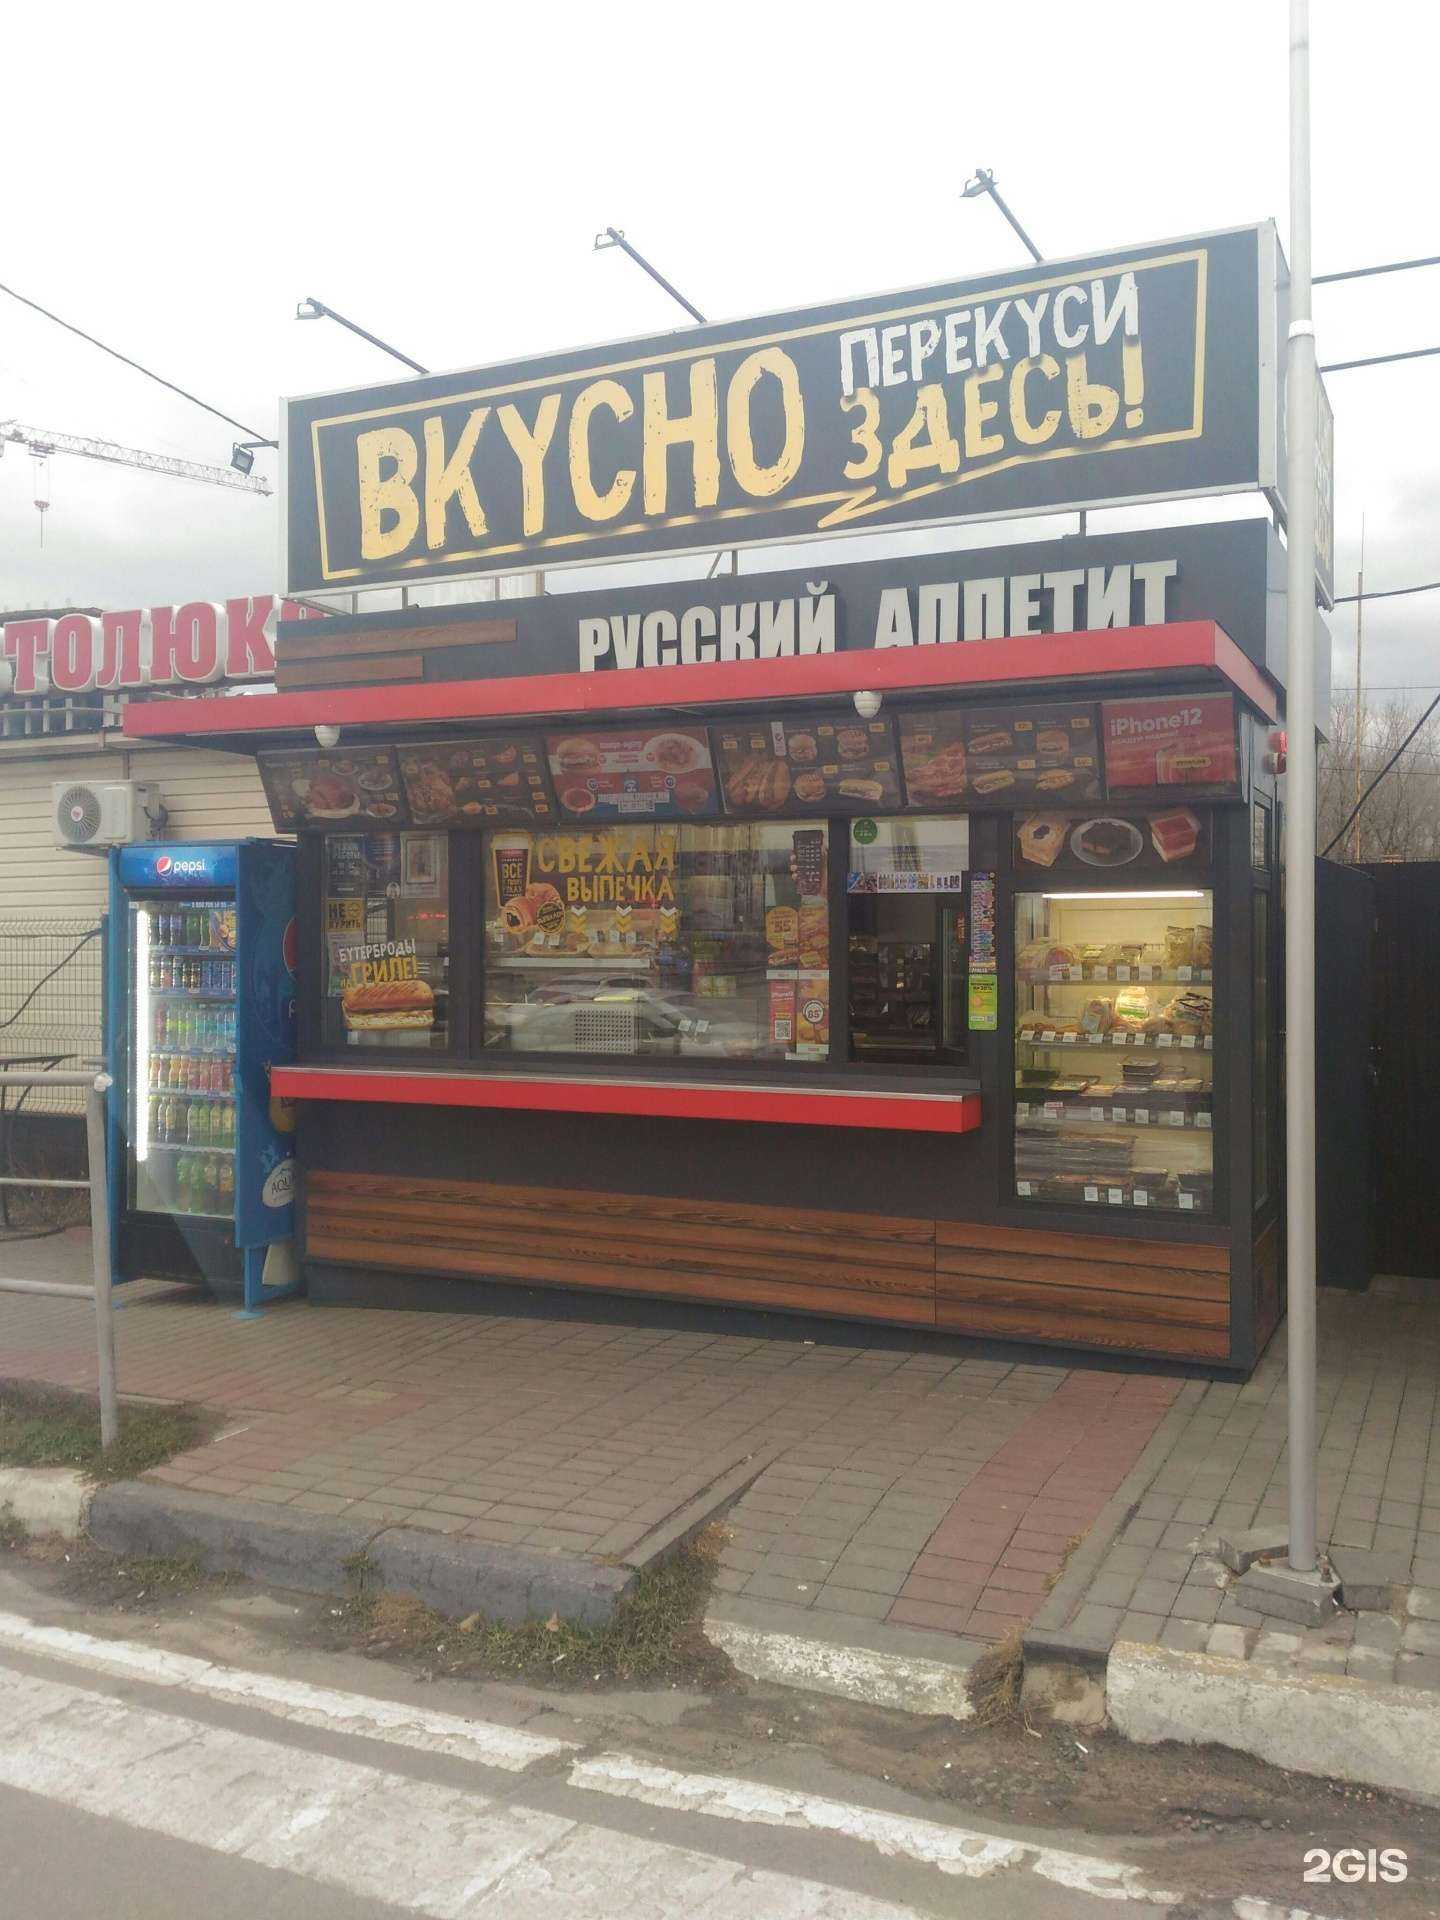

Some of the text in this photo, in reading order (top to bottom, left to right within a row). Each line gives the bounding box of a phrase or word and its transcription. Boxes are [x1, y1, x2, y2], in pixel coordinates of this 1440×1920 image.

[840, 272, 1140, 397] ПЕРЕКУСИ
[842, 341, 1145, 488] ЗДЕСЬ!
[356, 346, 805, 561] ВКУСНО
[0, 595, 327, 693] ТОЛЮК
[577, 560, 1178, 673] РУССКИЙ АППЕТИТ
[173, 857, 206, 874] pepsi
[537, 836, 676, 873] СВЕЖАЯ
[328, 902, 346, 919] НЕ
[567, 875, 675, 902] ВЫПЕЧКА
[338, 938, 416, 962] БУТЕРБРОДЫ
